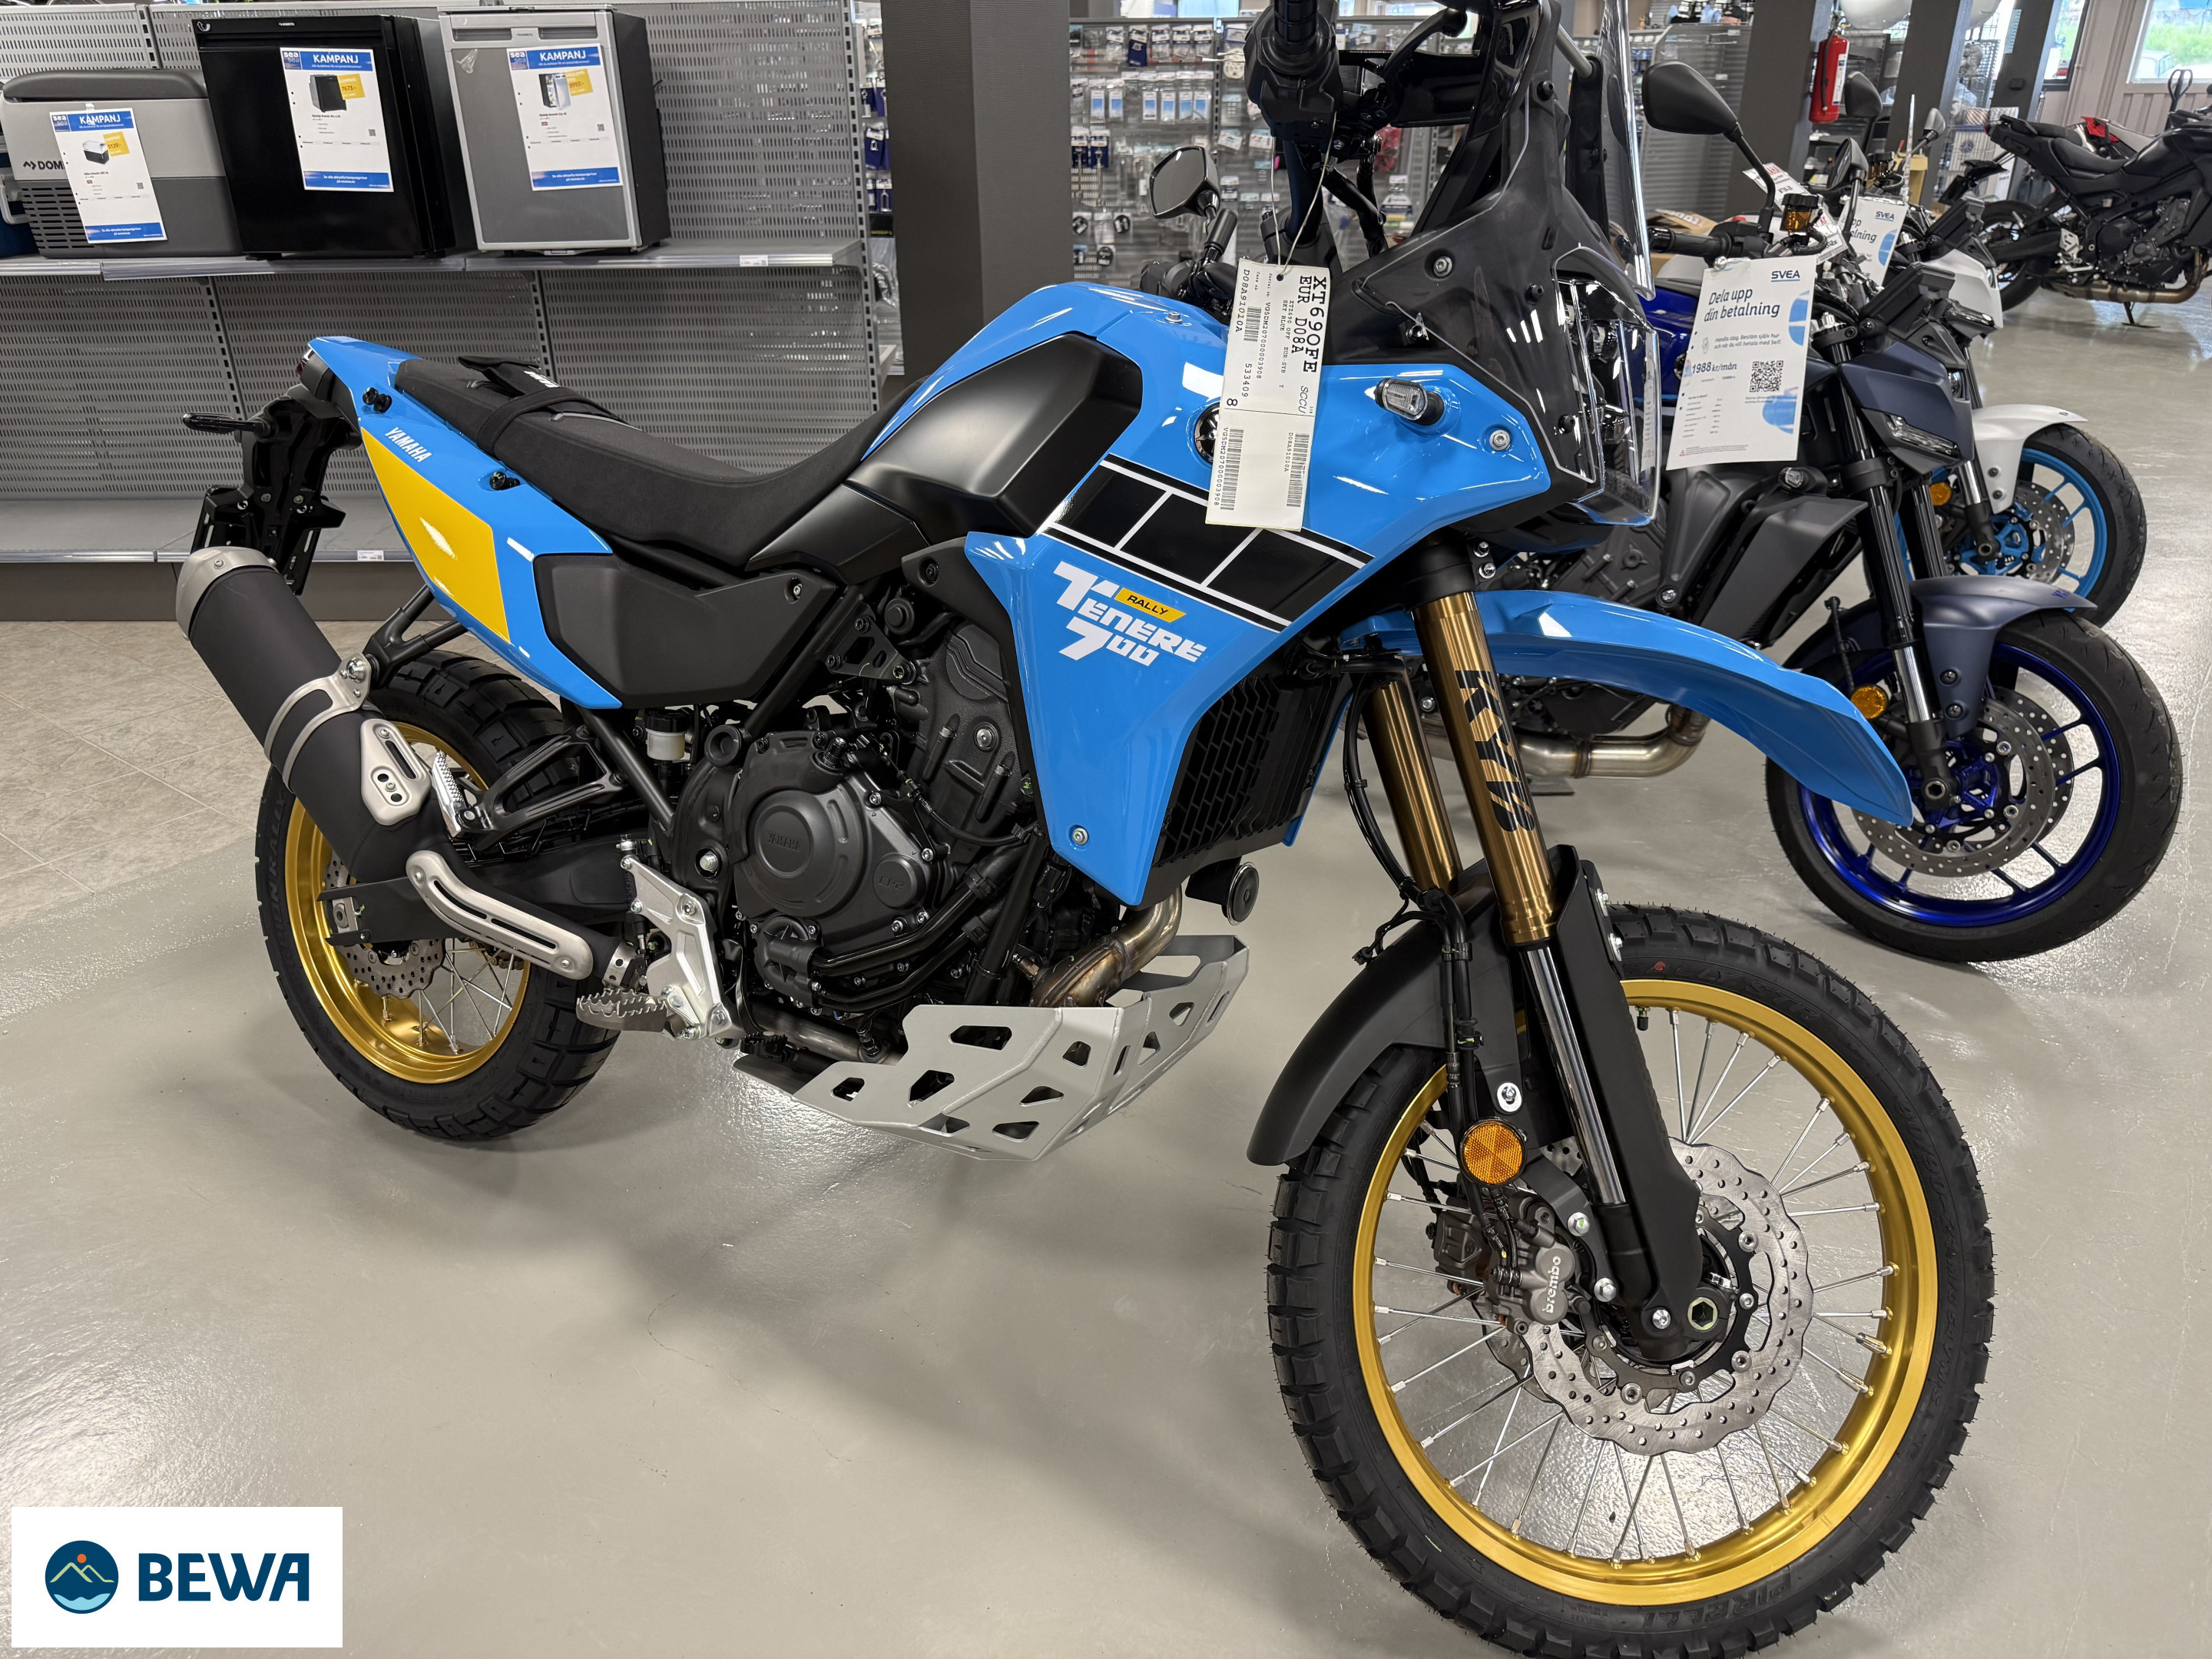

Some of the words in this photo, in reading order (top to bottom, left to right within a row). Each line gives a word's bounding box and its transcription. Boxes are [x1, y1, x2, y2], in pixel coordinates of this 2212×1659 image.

[313, 55, 359, 64] KAMPANJ
[539, 50, 586, 61] KAMPANJ
[79, 114, 121, 124] KAMPANJ
[38, 161, 66, 170] DOM
[1876, 211, 1895, 220] SVEA
[1771, 270, 1800, 279] SVEA
[1297, 276, 1312, 303] EUR
[1708, 289, 1730, 305] Dela
[1731, 289, 1753, 303] upp
[1704, 309, 1718, 323] din
[1720, 303, 1780, 320] betalning
[1291, 317, 1307, 353] D08A
[1692, 362, 1711, 375] 1988
[1712, 363, 1737, 373] kr/mån
[1242, 363, 1252, 397] 533409
[1227, 398, 1238, 406] 8
[1298, 386, 1309, 413] SCCU
[385, 427, 432, 462] YAMAHA
[1127, 595, 1169, 615] RALLY
[1058, 616, 1160, 667] 700
[1455, 670, 1535, 833] KYB
[1542, 1256, 1561, 1313] brembo
[1643, 1572, 1792, 1628] PIRELLI
